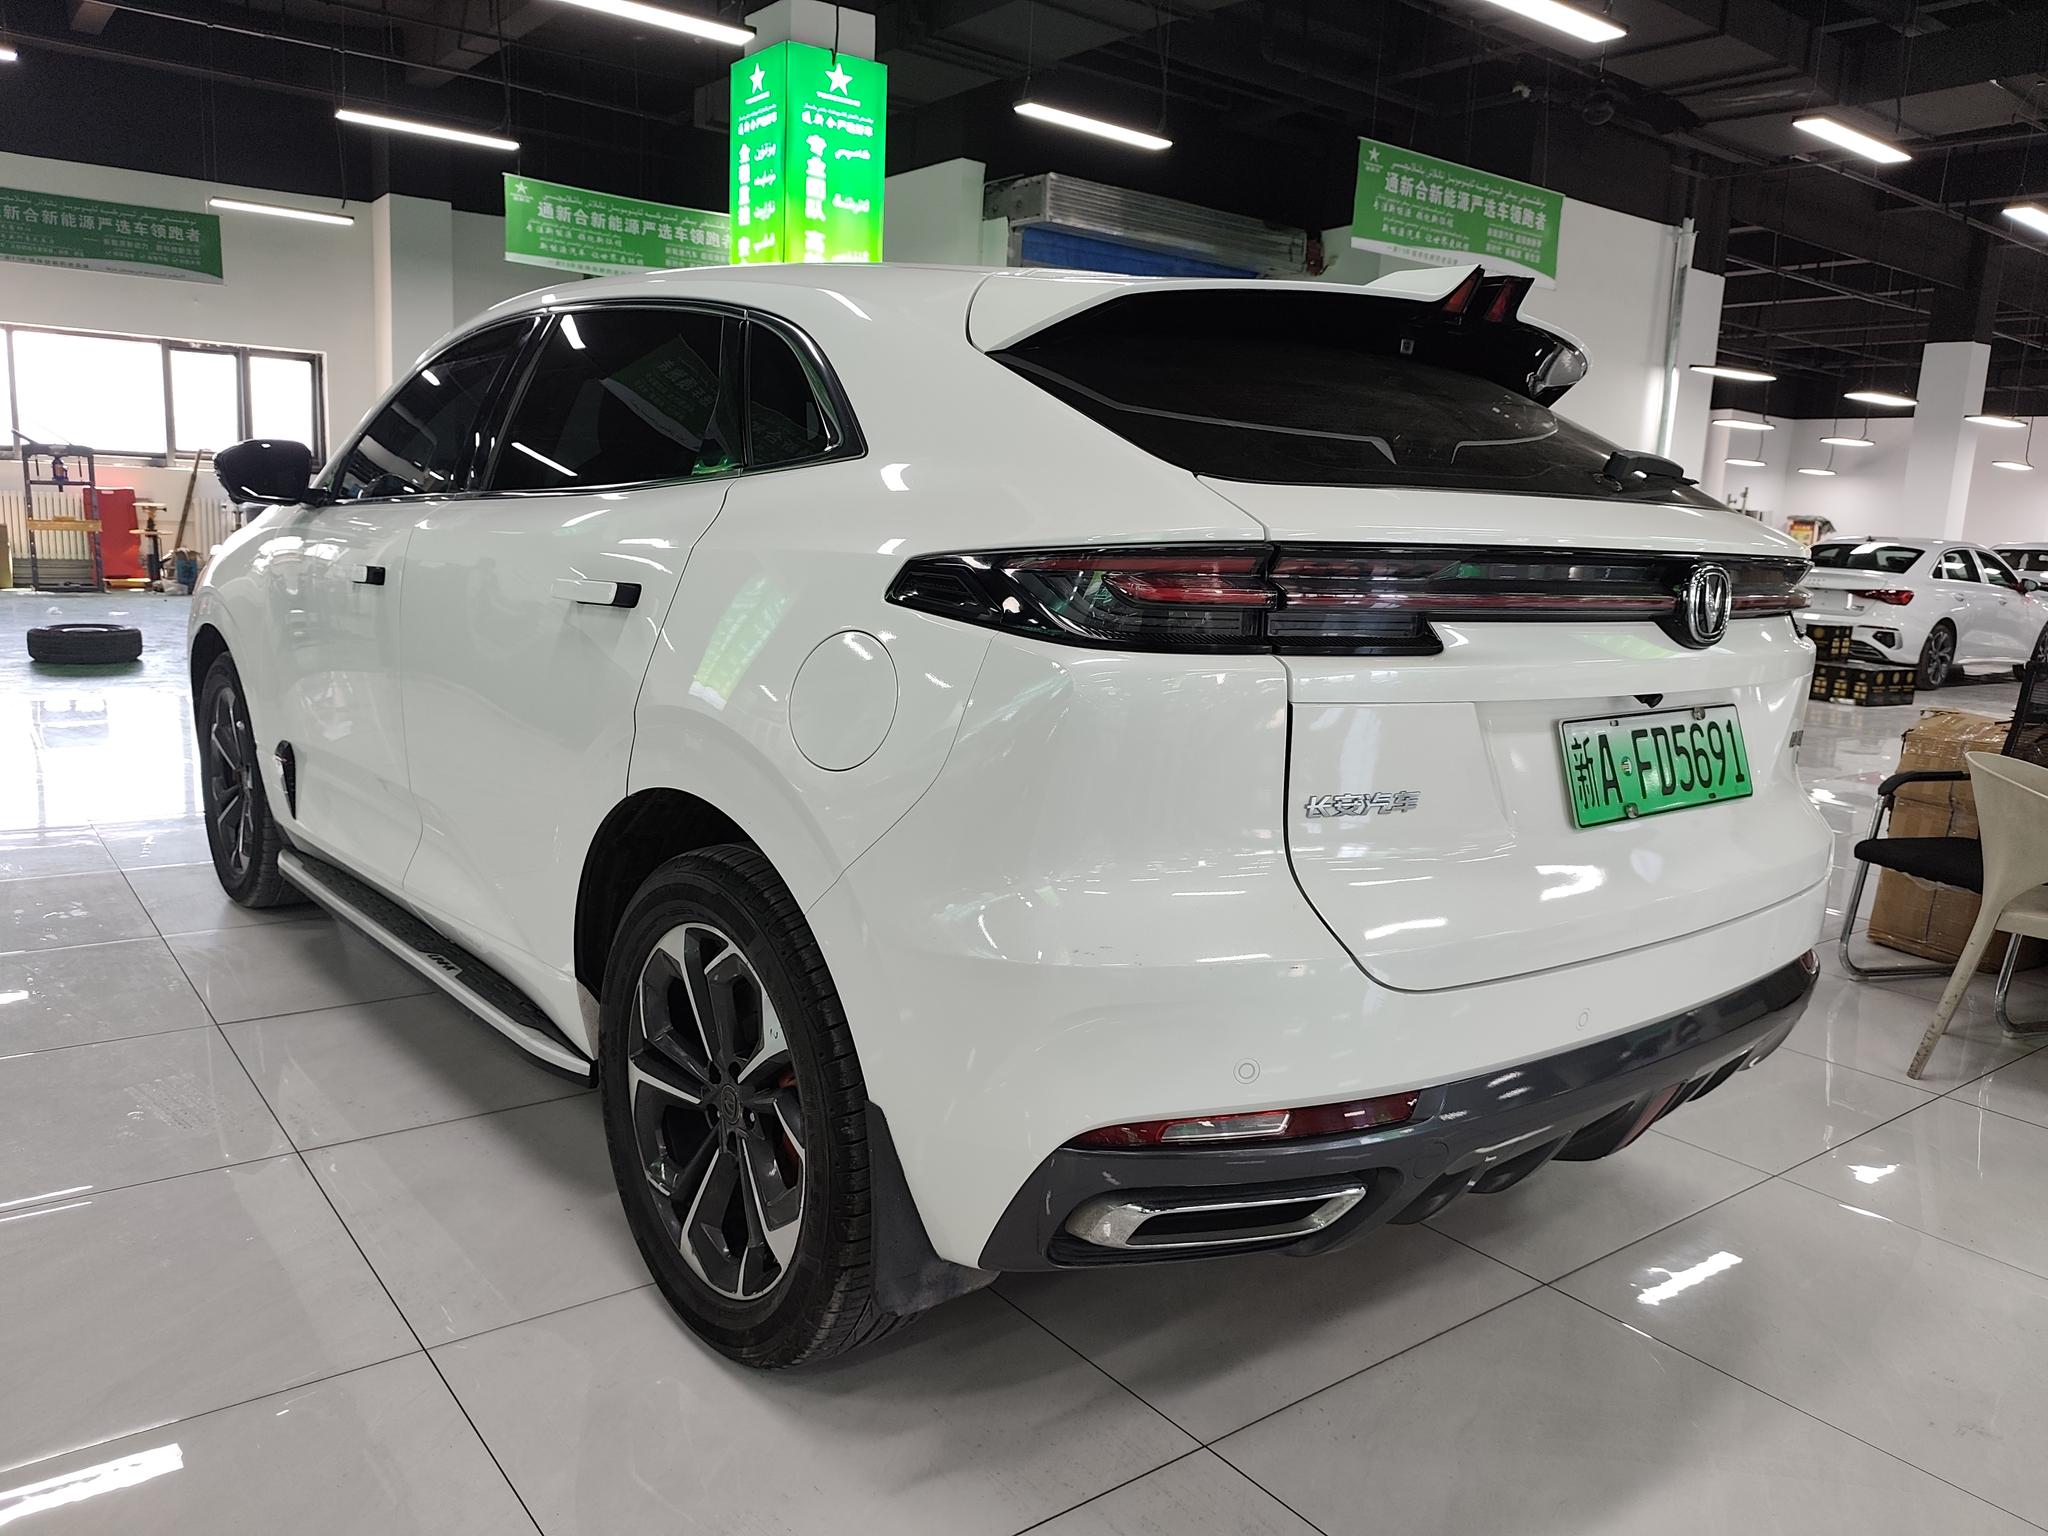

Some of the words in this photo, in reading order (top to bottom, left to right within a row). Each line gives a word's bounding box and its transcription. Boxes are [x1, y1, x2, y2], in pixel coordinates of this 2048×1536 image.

[1385, 171, 1547, 231] 通新合新能源严选车领跑者
[0, 204, 201, 242] 新合新能源严选车领跑者
[1304, 790, 1421, 818] 长安汽车
